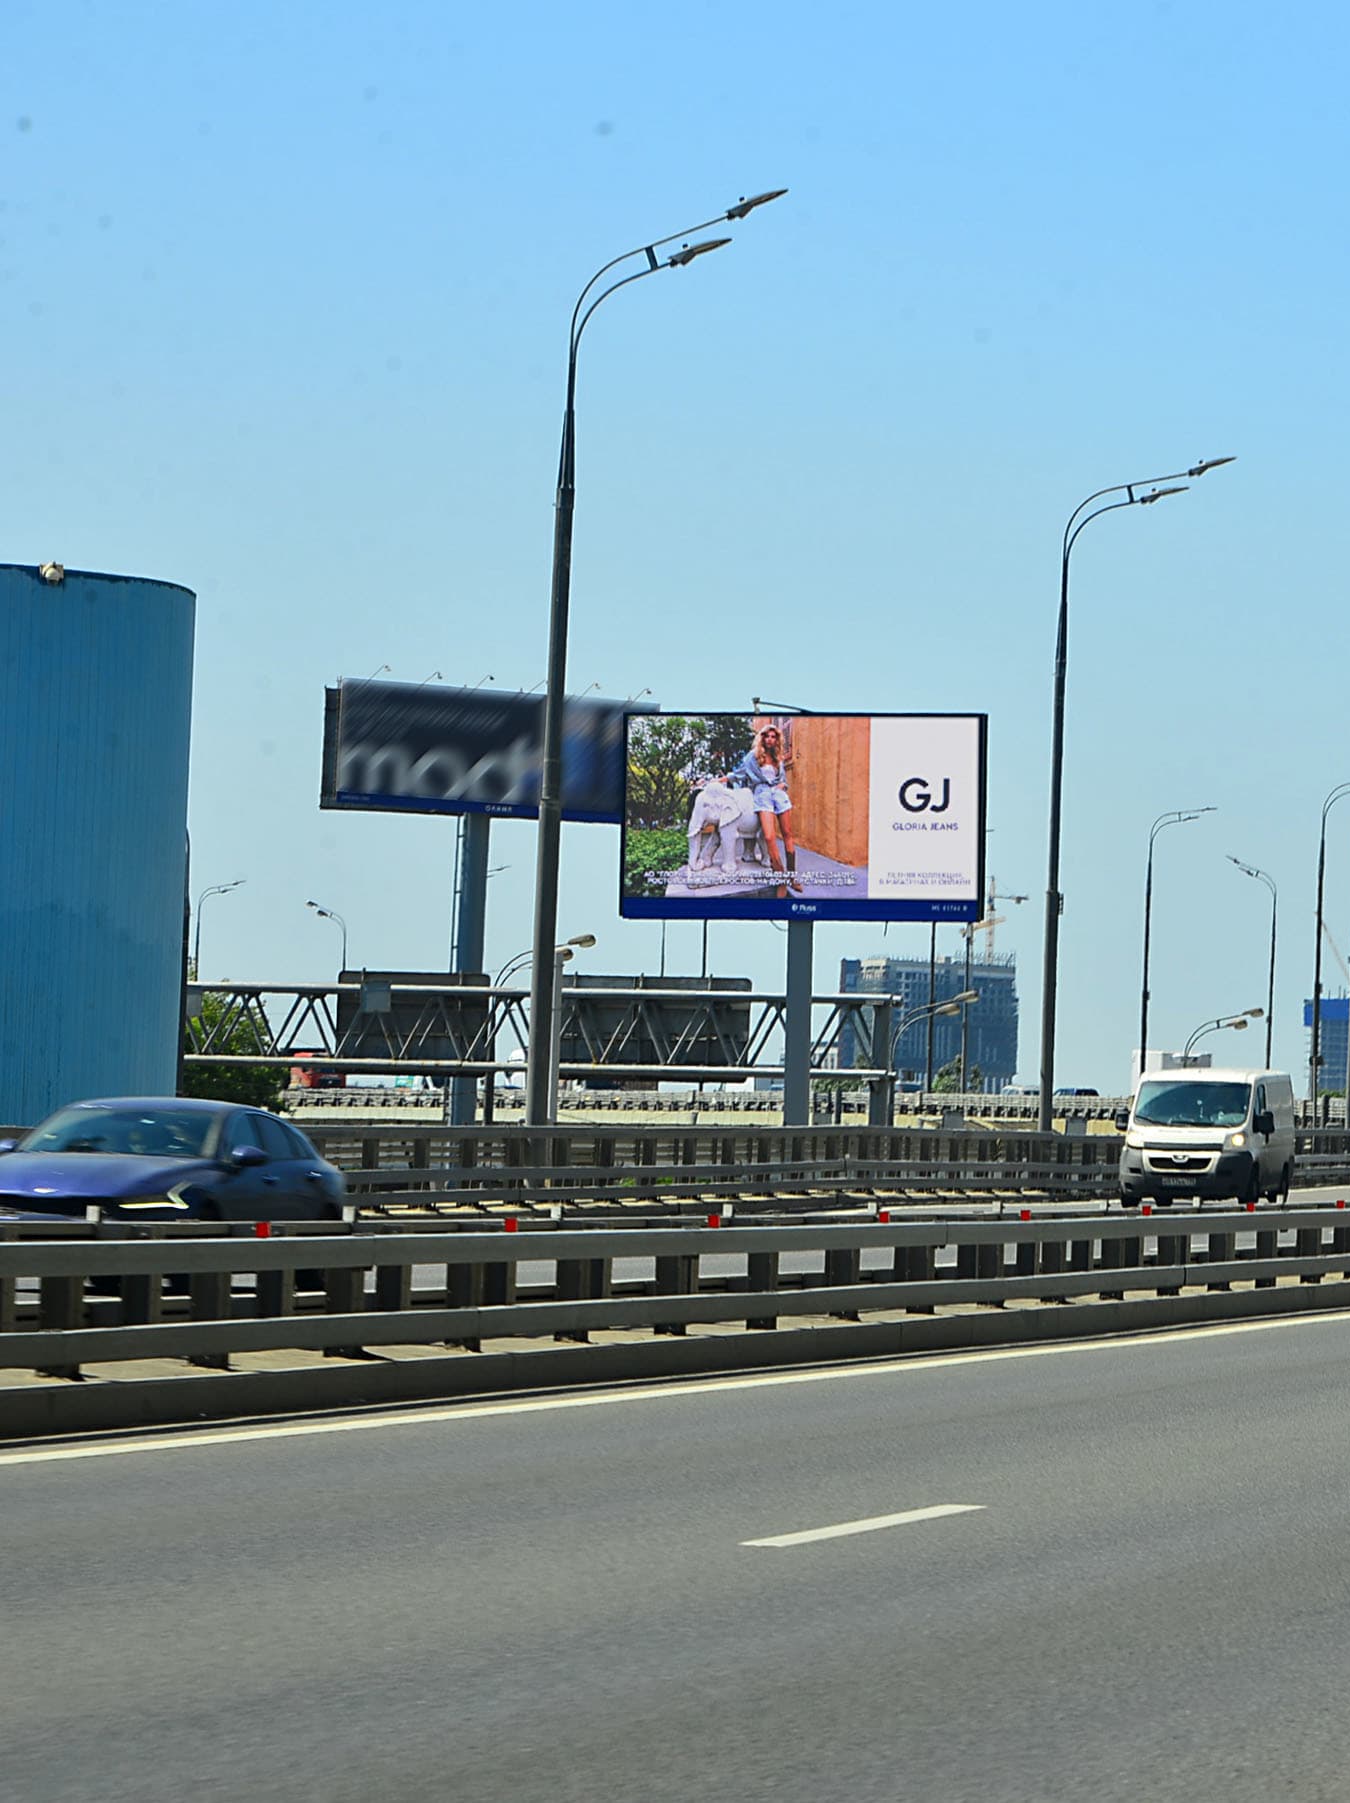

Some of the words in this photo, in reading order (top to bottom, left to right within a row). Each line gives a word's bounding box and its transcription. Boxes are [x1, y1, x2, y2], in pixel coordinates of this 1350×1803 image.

[899, 777, 950, 812] GJ
[892, 823, 927, 831] GLORIA
[930, 823, 958, 831] JEANS
